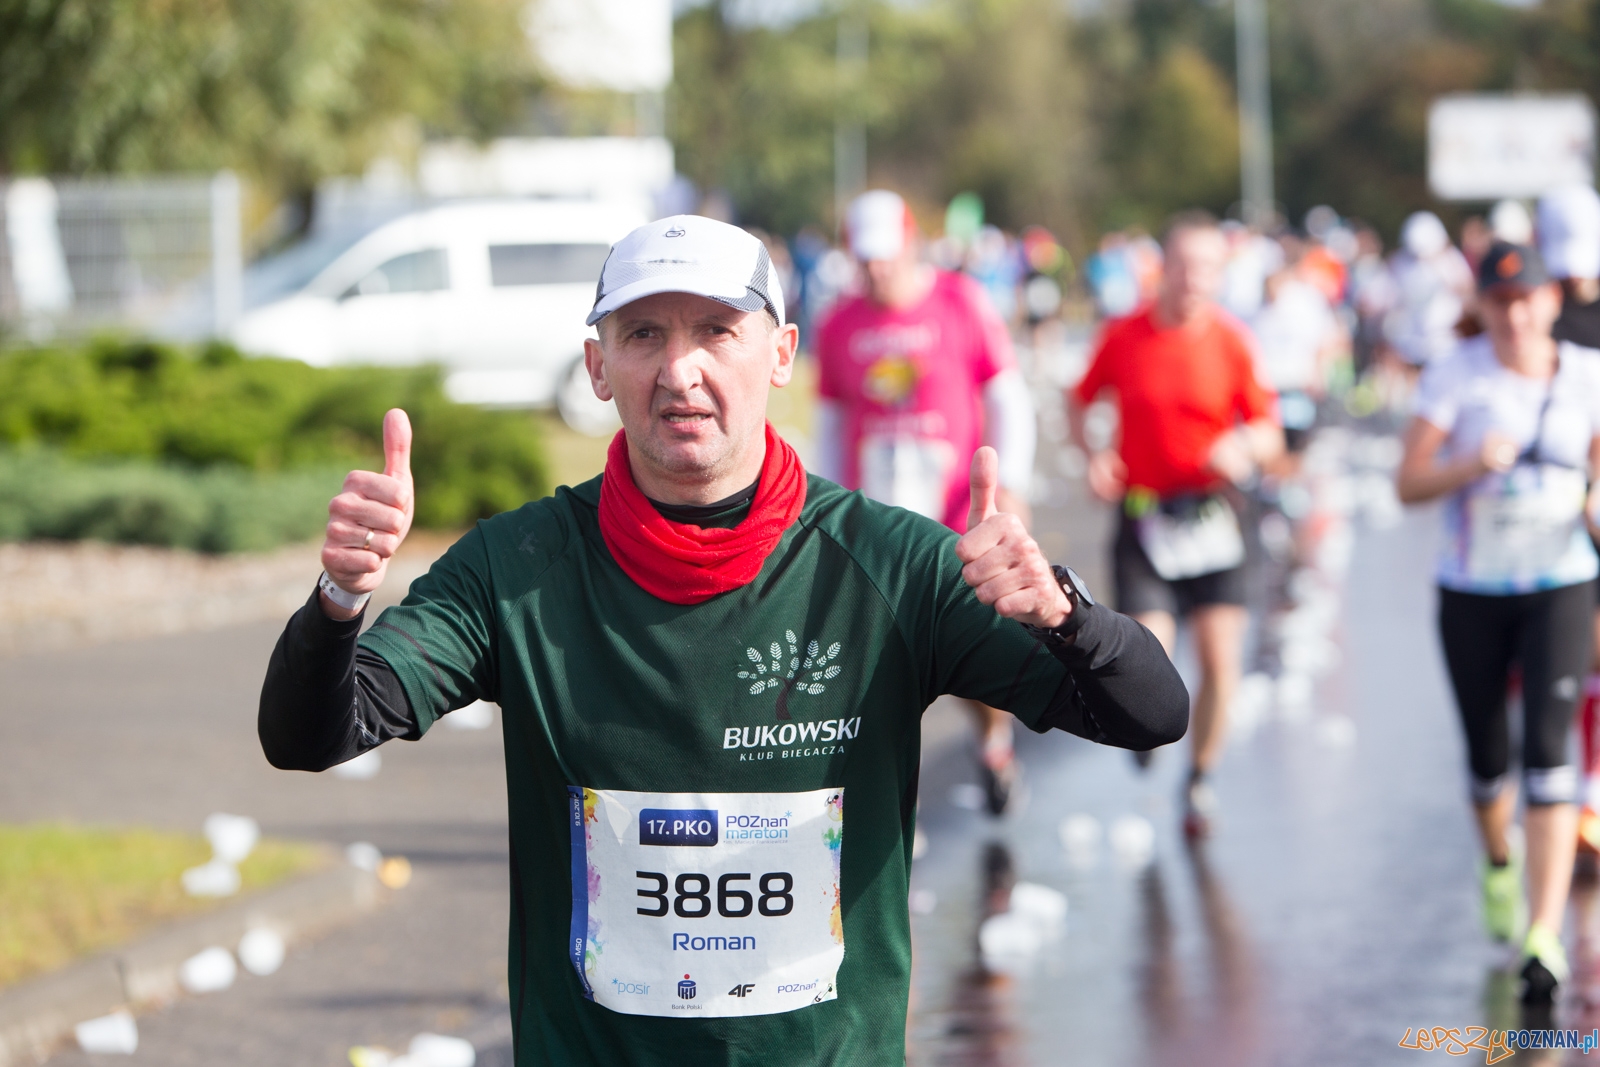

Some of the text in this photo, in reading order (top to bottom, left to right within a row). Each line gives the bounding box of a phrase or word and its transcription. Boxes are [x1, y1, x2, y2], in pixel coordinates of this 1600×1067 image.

[723, 717, 861, 749] BUKOWSKI
[740, 745, 845, 761] KLUB BIEGACZA
[647, 819, 712, 836] 17. PKO
[726, 827, 788, 839] maraton
[636, 871, 794, 918] 3868
[672, 933, 756, 951] Roman
[728, 984, 755, 997] 4F
